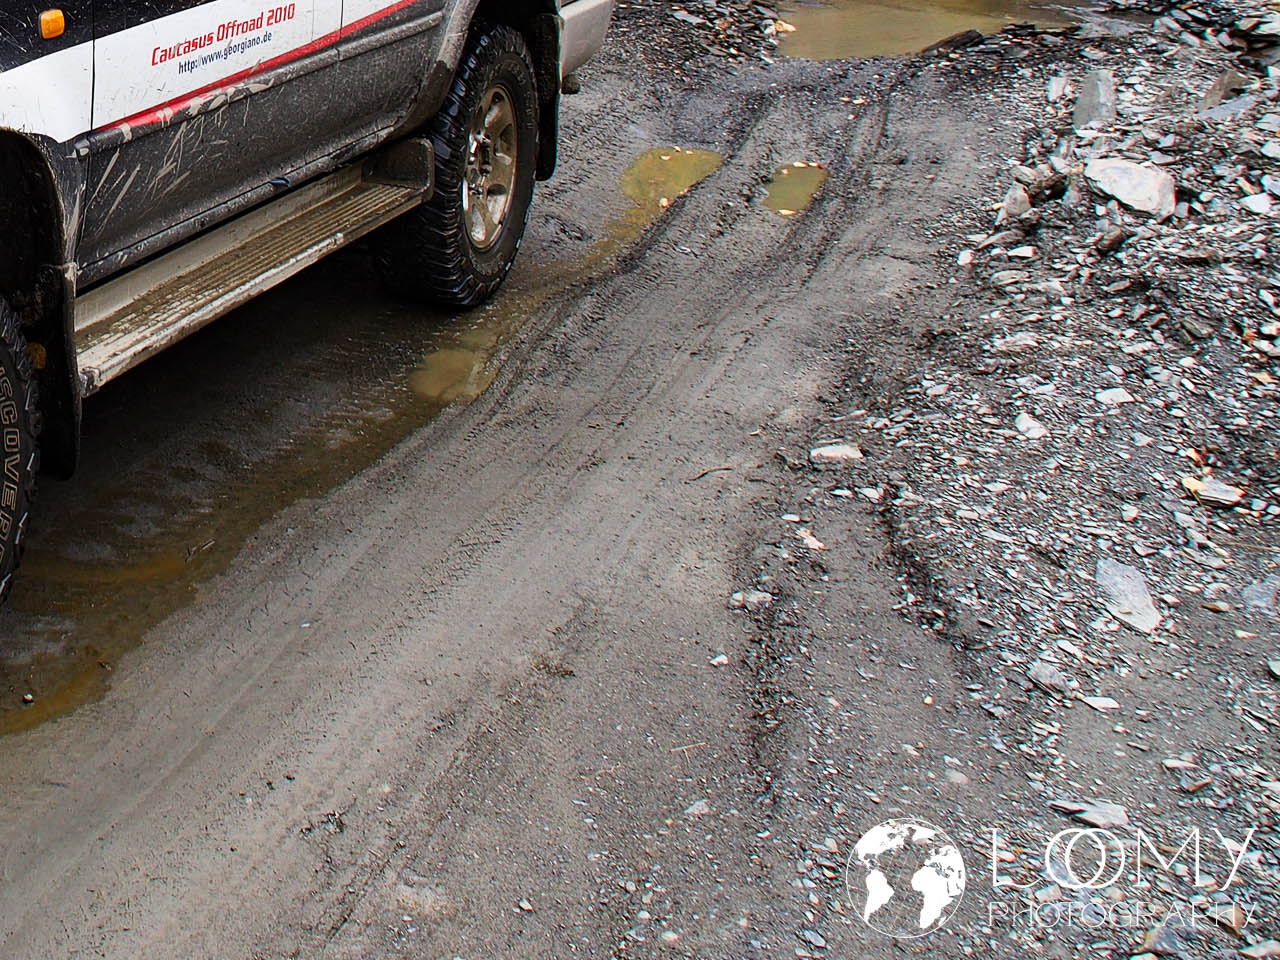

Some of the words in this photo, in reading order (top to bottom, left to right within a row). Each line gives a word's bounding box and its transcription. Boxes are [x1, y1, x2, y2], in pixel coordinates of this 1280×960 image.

[151, 32, 214, 67] Caucasus
[217, 12, 264, 42] Offroad
[267, 3, 296, 26] 2010
[178, 31, 272, 75] http://www.georgiano.de
